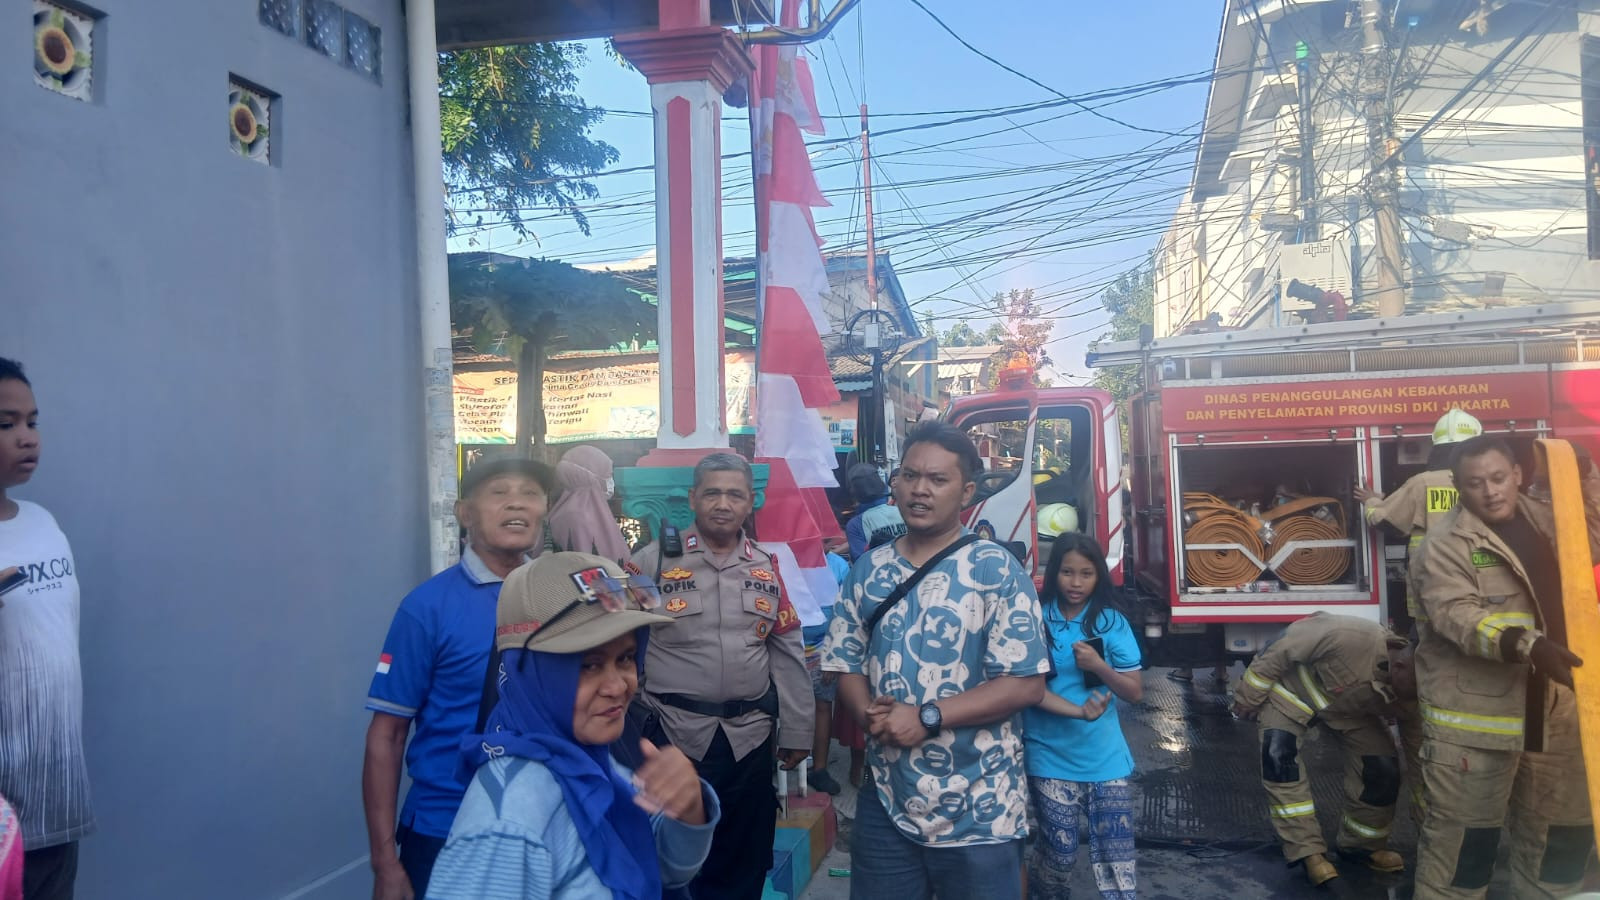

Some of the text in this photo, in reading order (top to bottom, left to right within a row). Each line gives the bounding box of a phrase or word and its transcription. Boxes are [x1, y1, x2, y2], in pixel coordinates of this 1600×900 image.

[494, 376, 518, 385] SED
[1204, 383, 1489, 405] DINAS PENANGGULANGAN KEBAKARAN
[1186, 398, 1511, 421] DAN PENYELAMATAN PROVINSI DKI JAKARTA
[744, 580, 779, 595] POLRI
